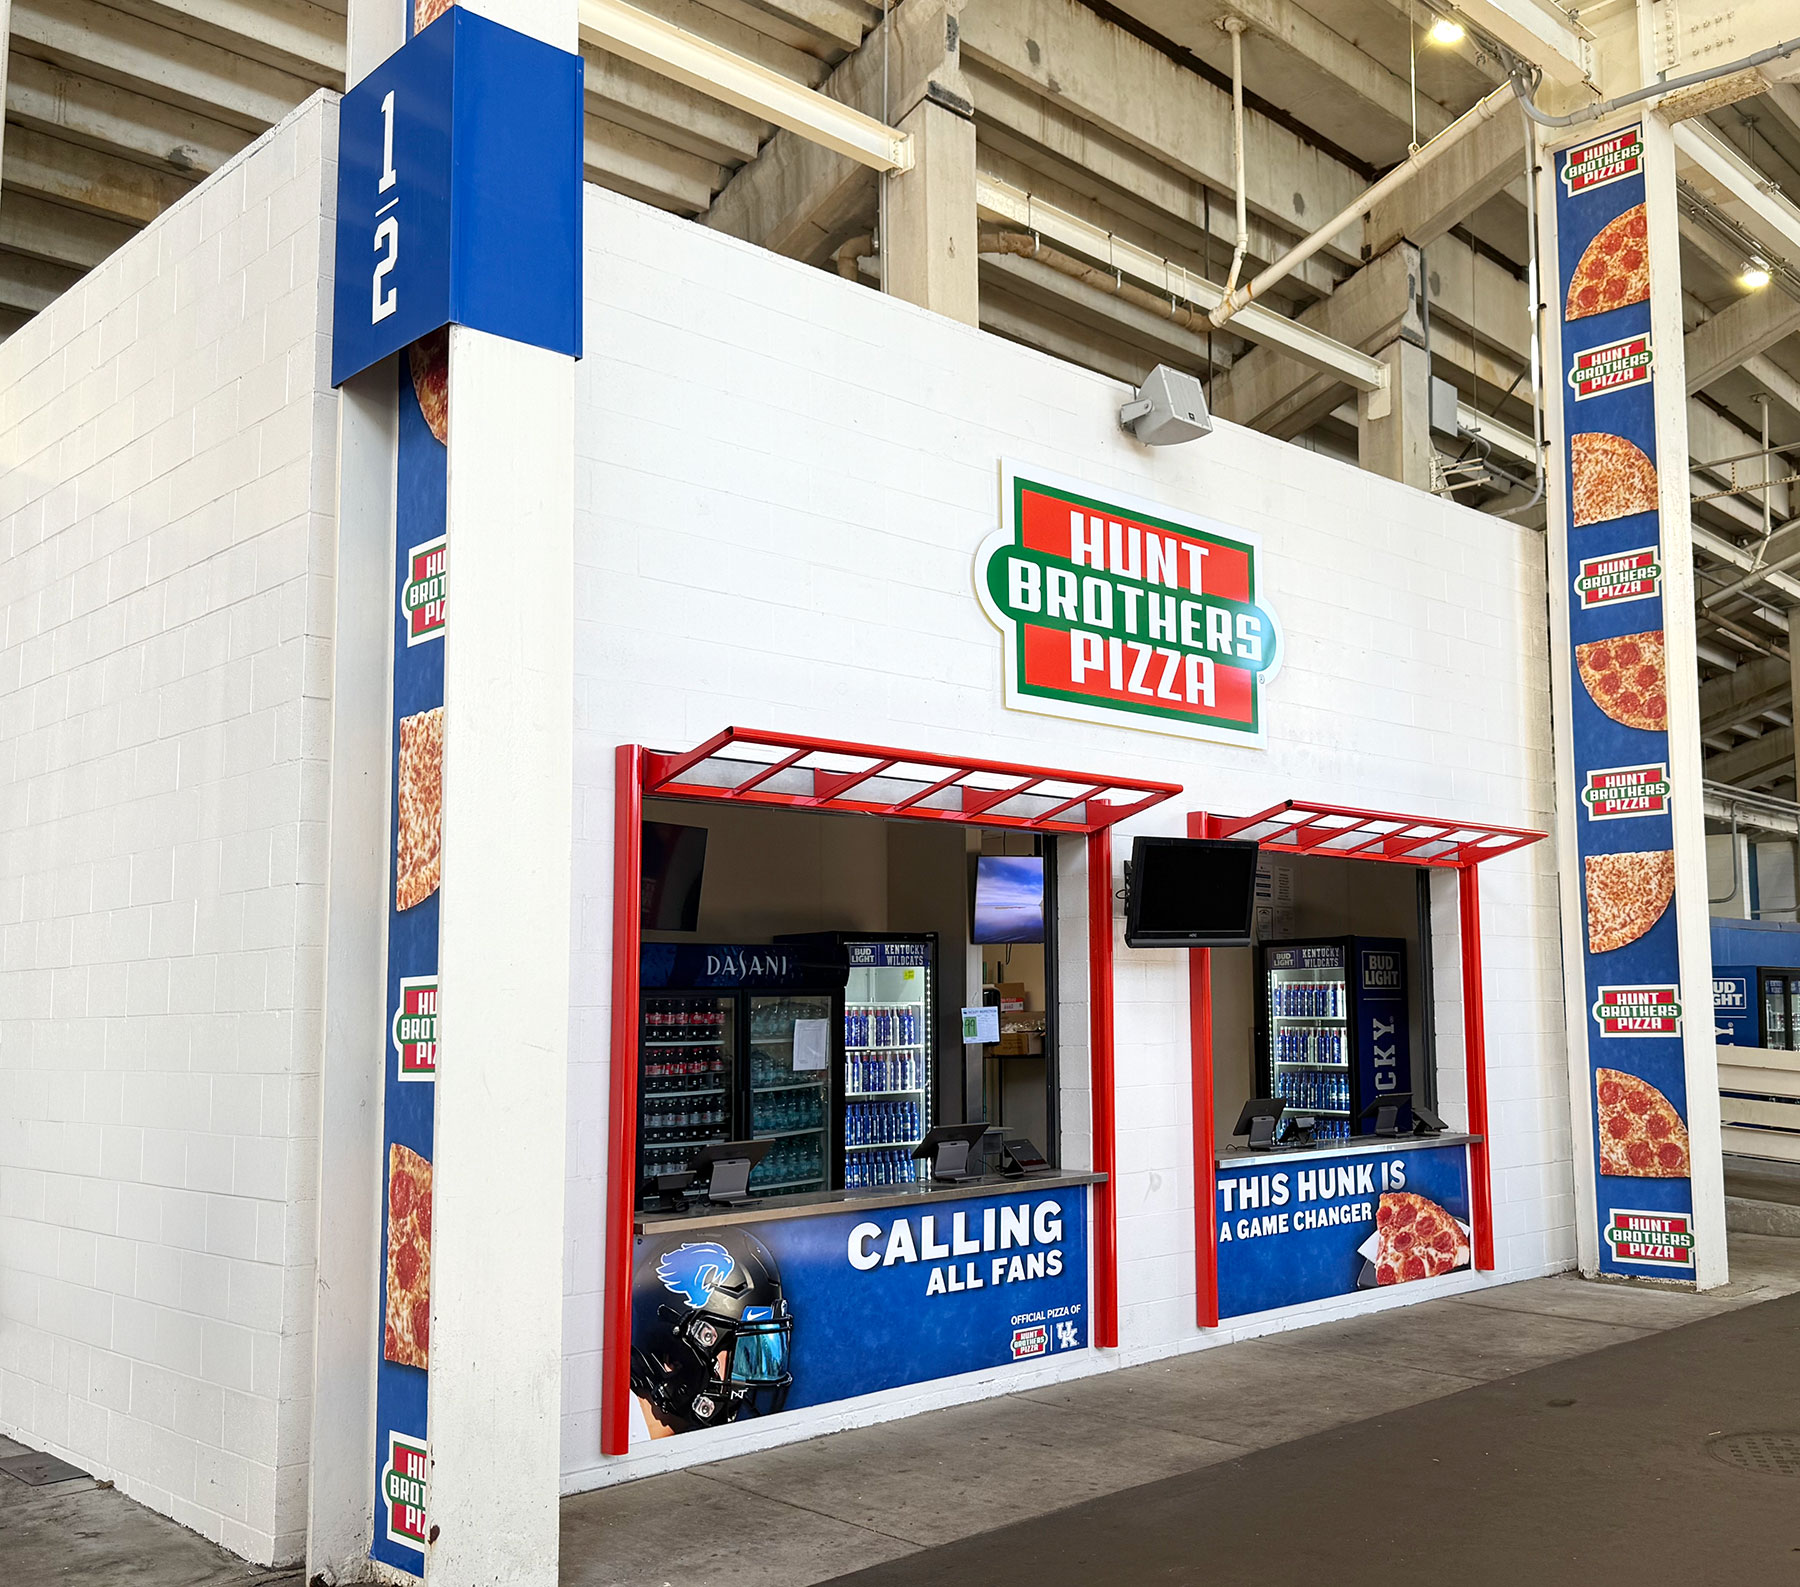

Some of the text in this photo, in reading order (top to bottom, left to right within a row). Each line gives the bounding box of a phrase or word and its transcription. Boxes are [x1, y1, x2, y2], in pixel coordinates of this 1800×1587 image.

[1583, 138, 1623, 162] HUNT
[1568, 144, 1640, 178] BROTHERS
[1584, 160, 1625, 184] PIZZA
[1591, 344, 1632, 366] HUNT
[1576, 353, 1649, 381] BROTHERS
[1591, 368, 1634, 389] PIZZA
[1070, 510, 1209, 596] HUNT
[1598, 557, 1639, 575] HUNT
[1582, 566, 1657, 589] BROTHERS
[1598, 581, 1641, 598] PIZZA
[1008, 556, 1262, 661] BROTHERS
[1070, 628, 1216, 707] PIZZA
[1605, 772, 1647, 788] HUNT
[1589, 783, 1665, 801] BROTHERS
[1606, 796, 1650, 811] PIZZA
[851, 954, 875, 963] LIGHT
[854, 947, 871, 956] BUD
[885, 944, 925, 955] KENTUCKY
[1302, 948, 1339, 958] KENTUCKY
[707, 950, 787, 981] DASANI
[886, 955, 924, 966] WILDCATS
[1304, 957, 1339, 967] WILDCATS
[1369, 955, 1393, 970] BUD
[1365, 970, 1399, 985] LIGHT
[1616, 992, 1659, 1005] HUNT
[1601, 1004, 1678, 1017] BROTHERS
[1617, 1017, 1662, 1030] PIZZA
[1218, 1160, 1406, 1212] THIS HUNK IS
[1219, 1202, 1372, 1243] A GAME CHANGER
[1628, 1217, 1672, 1232] HUNT
[848, 1201, 1062, 1270] CALLING
[1612, 1229, 1690, 1246] BROTHERS
[1630, 1242, 1674, 1258] PIZZA
[926, 1250, 1063, 1296] ALL FANS
[1011, 1304, 1081, 1325] OFFICIAL PIZZA OF
